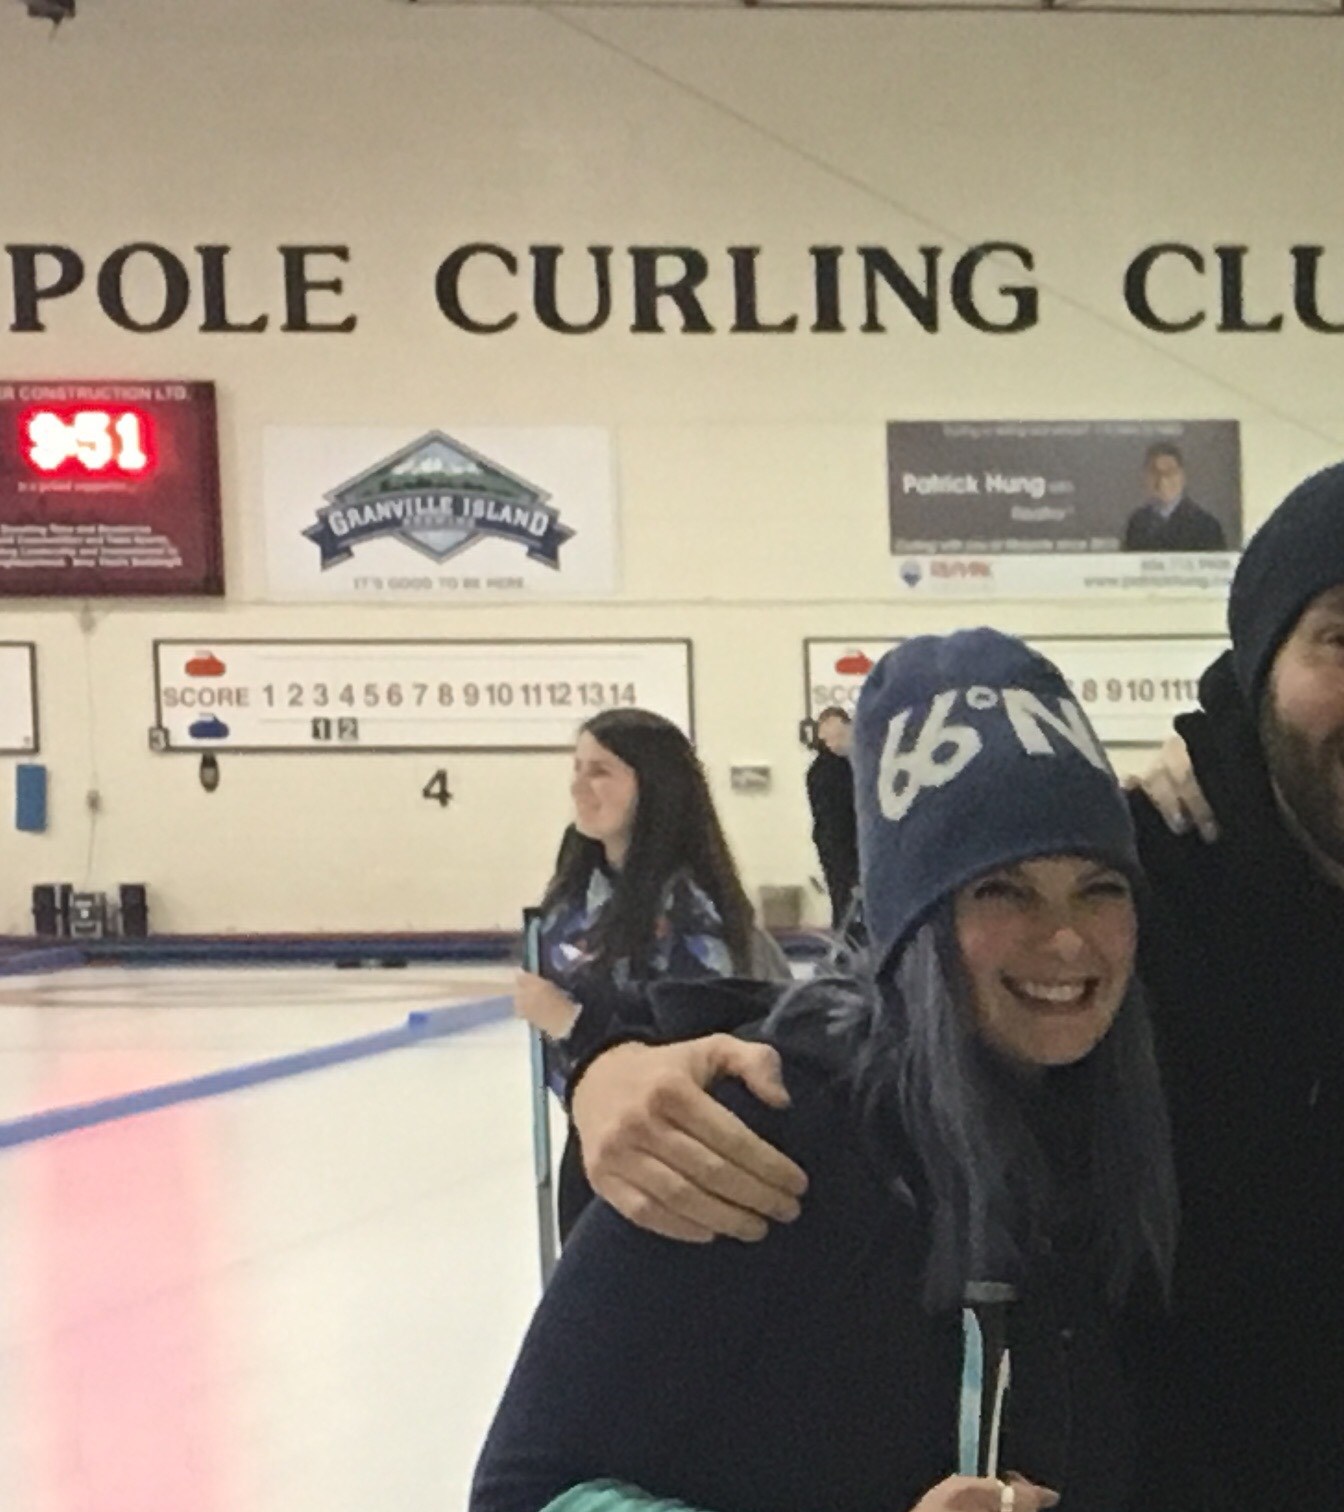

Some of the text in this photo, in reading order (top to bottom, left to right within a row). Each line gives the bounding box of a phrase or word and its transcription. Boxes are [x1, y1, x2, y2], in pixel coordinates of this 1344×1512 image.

[4, 242, 358, 333] POLE
[434, 241, 1039, 334] CURLING
[903, 473, 979, 495] Patrick
[984, 473, 1046, 499] Hung
[327, 496, 551, 537] GRANVILLE ISLAND
[163, 683, 636, 707] SCORE 1 2 3 4 5 6 7 8 9 10 11 12 13 14
[1082, 678, 1098, 702] 8
[1107, 678, 1122, 702] 9
[1127, 678, 1154, 702] 10
[422, 768, 453, 808] 4
